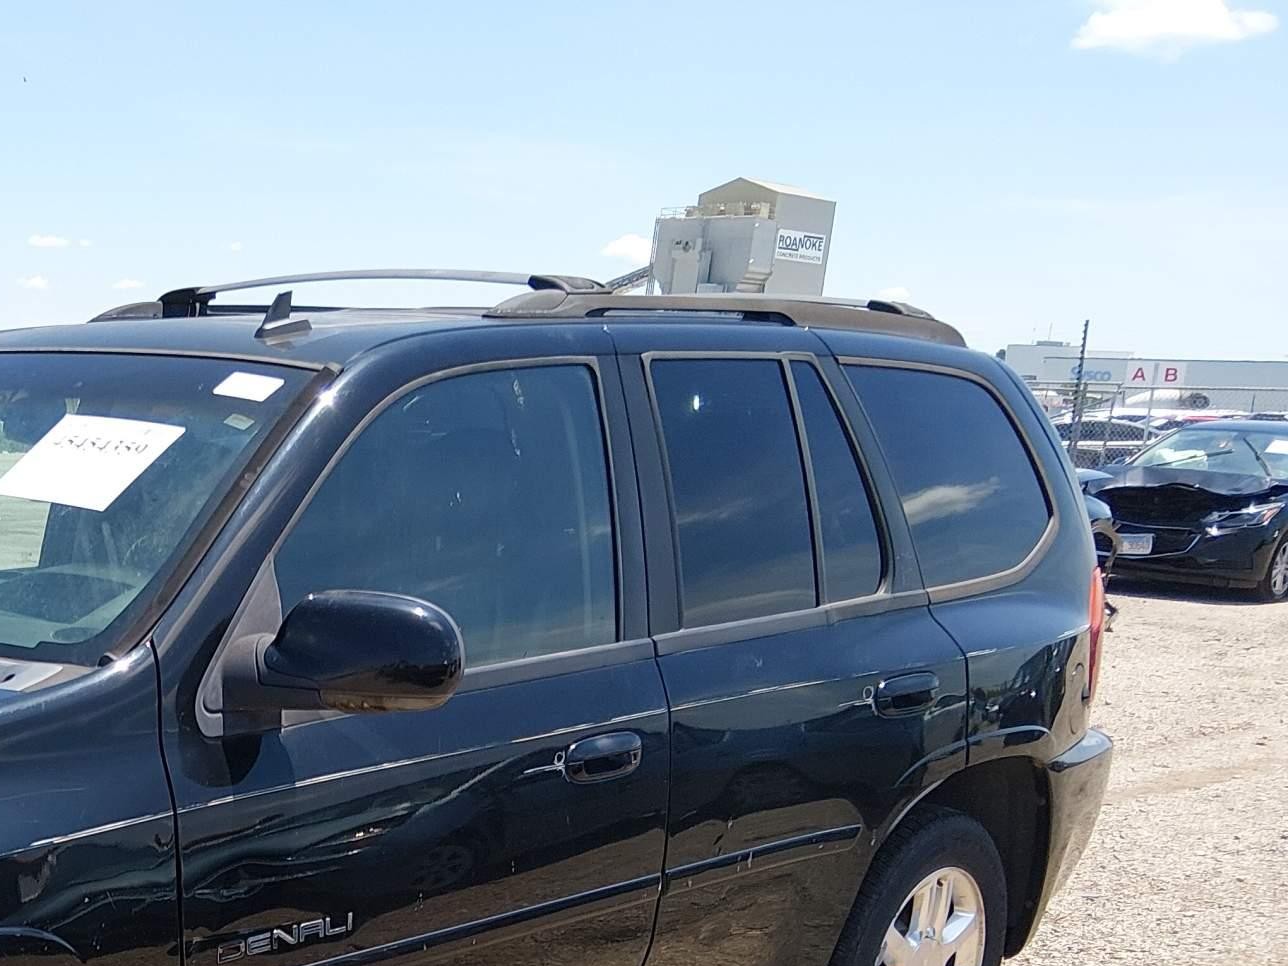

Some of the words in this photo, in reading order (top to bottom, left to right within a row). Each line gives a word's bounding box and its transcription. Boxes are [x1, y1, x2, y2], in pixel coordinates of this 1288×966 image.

[778, 235, 824, 251] ROANOKE
[1132, 367, 1146, 381] A
[1164, 367, 1178, 382] B
[217, 912, 353, 965] DENALI
